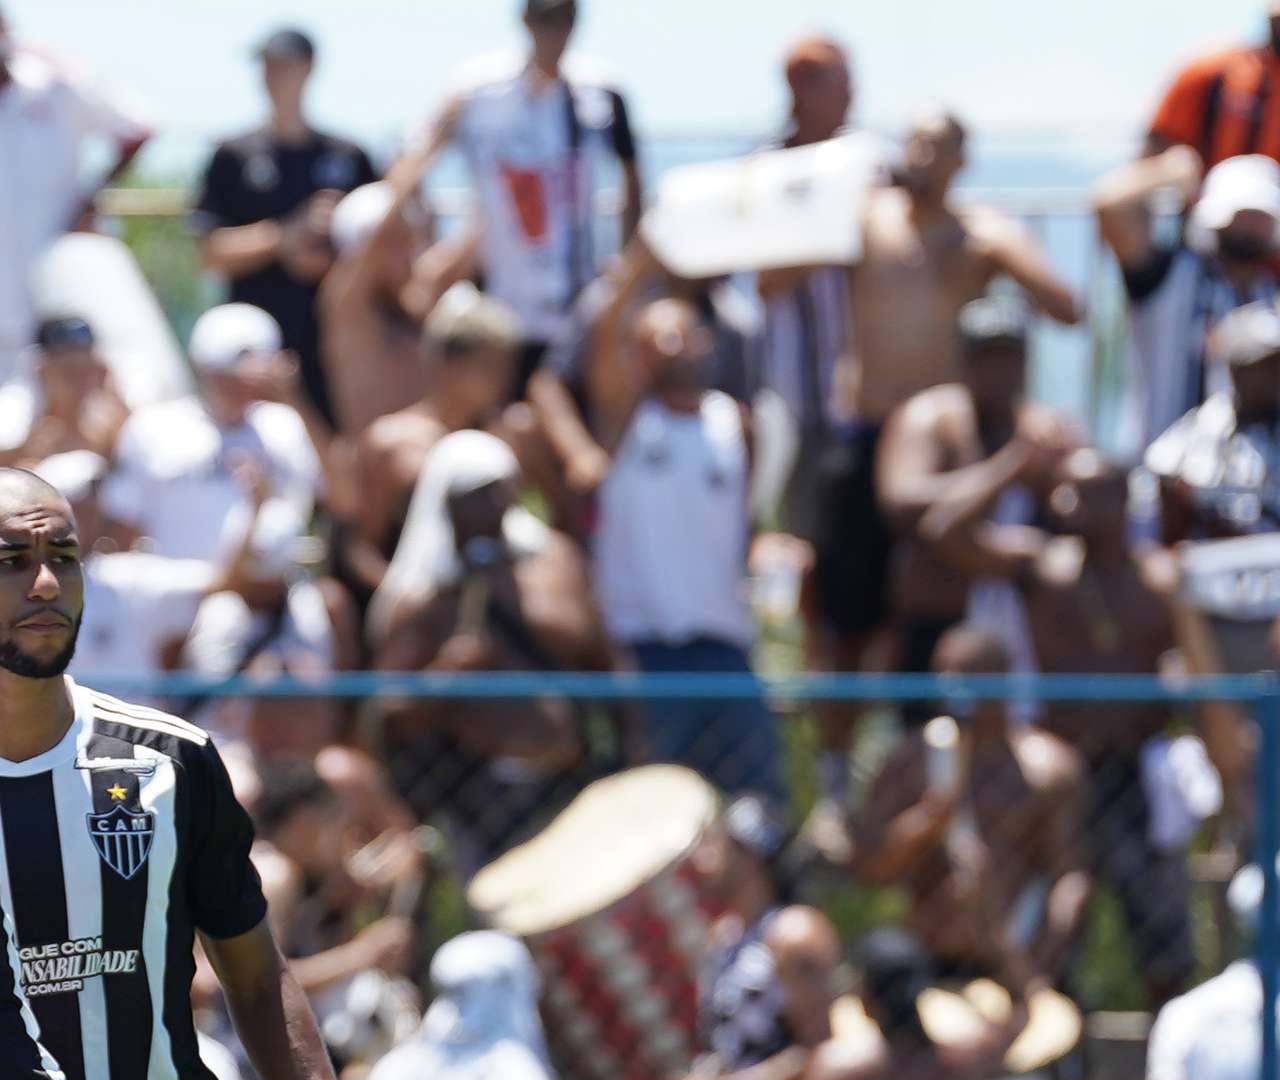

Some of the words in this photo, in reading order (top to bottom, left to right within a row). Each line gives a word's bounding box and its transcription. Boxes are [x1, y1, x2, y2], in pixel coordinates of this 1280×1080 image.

[97, 819, 146, 831] CAM
[61, 937, 102, 954] COM
[20, 949, 139, 984] NSABILIDADE
